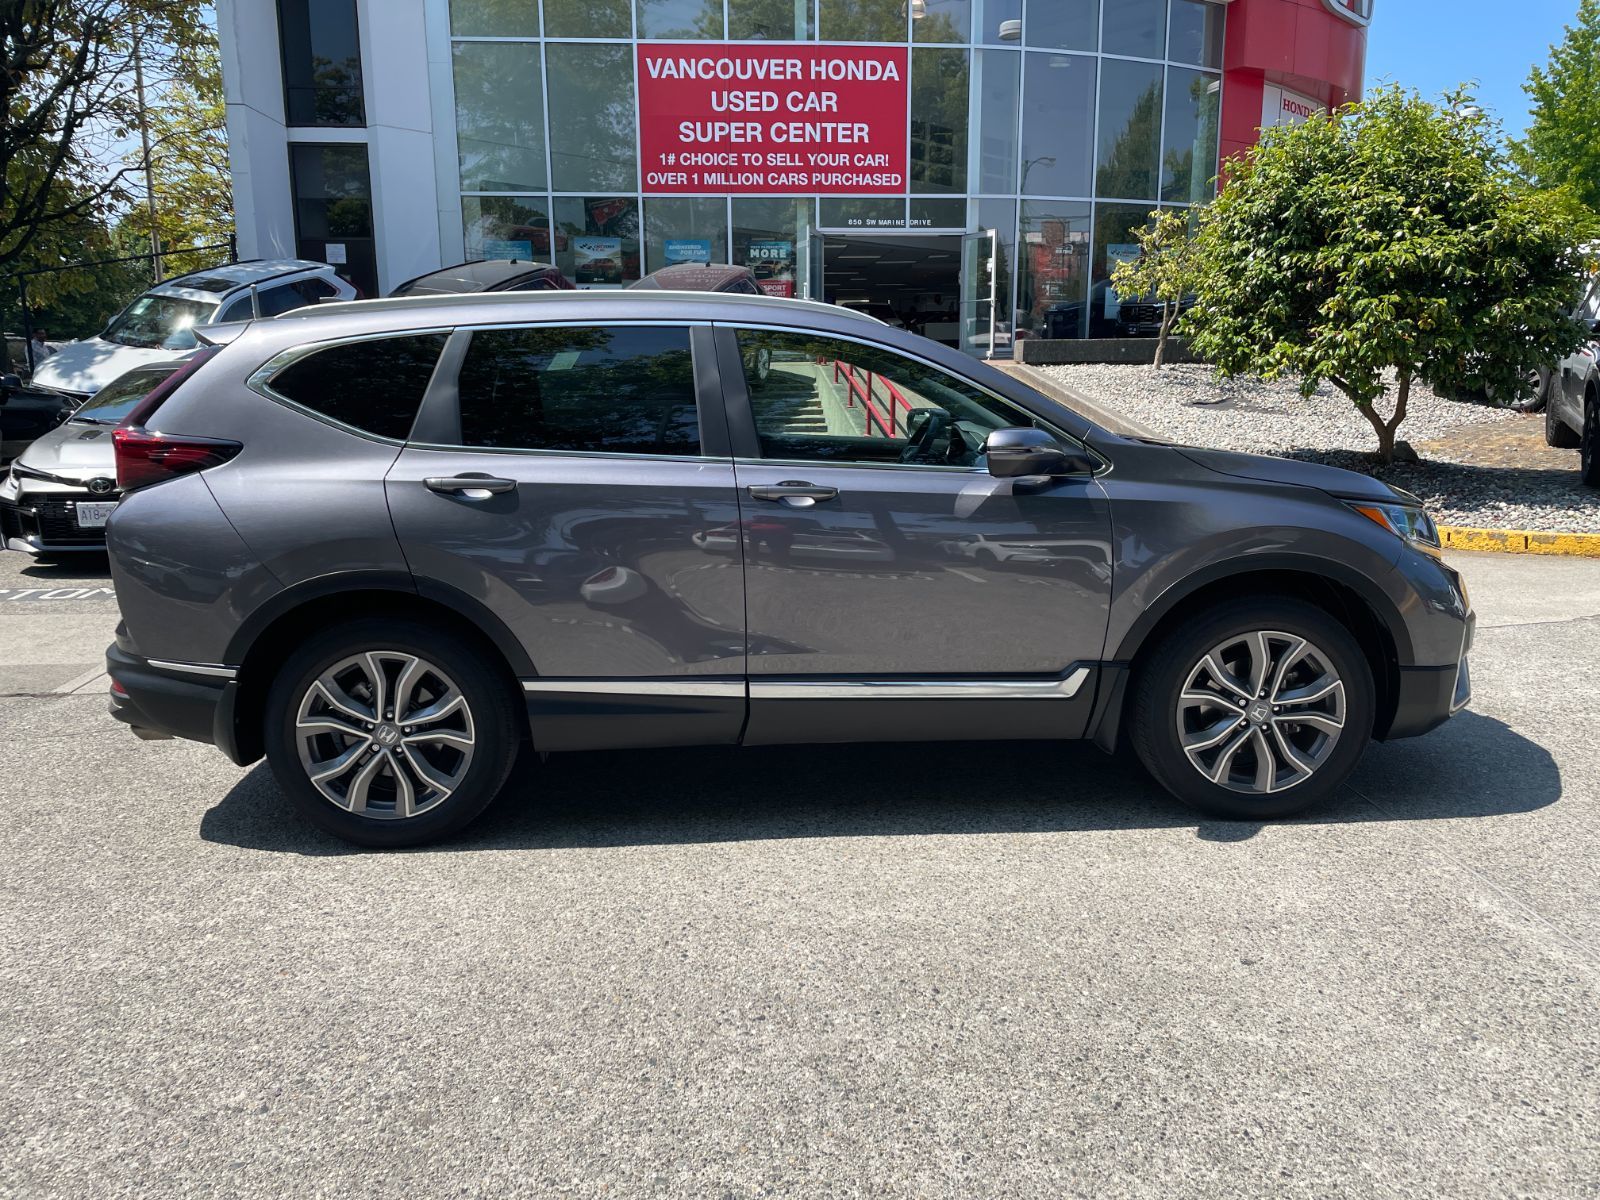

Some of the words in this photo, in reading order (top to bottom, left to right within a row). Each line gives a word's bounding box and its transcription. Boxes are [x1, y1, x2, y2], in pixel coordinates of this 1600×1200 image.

[645, 58, 802, 79] VANCOUVER
[810, 60, 900, 81] HONDA
[711, 91, 778, 112] USED
[786, 91, 838, 112] CAR
[1283, 98, 1315, 118] HOND
[679, 121, 762, 142] SUPER
[770, 122, 869, 143] CENTER
[659, 153, 676, 165] 1#
[680, 153, 738, 166] CHOICE
[742, 154, 762, 166] TO
[766, 154, 803, 166] SELL
[807, 154, 850, 166] YOUR
[853, 154, 889, 166] CAR!
[647, 173, 687, 185] OVER
[691, 173, 698, 184] 1
[704, 173, 763, 185] MILLION
[767, 173, 808, 185] CARS
[812, 173, 901, 186] PURCHASED
[750, 249, 786, 258] MORE
